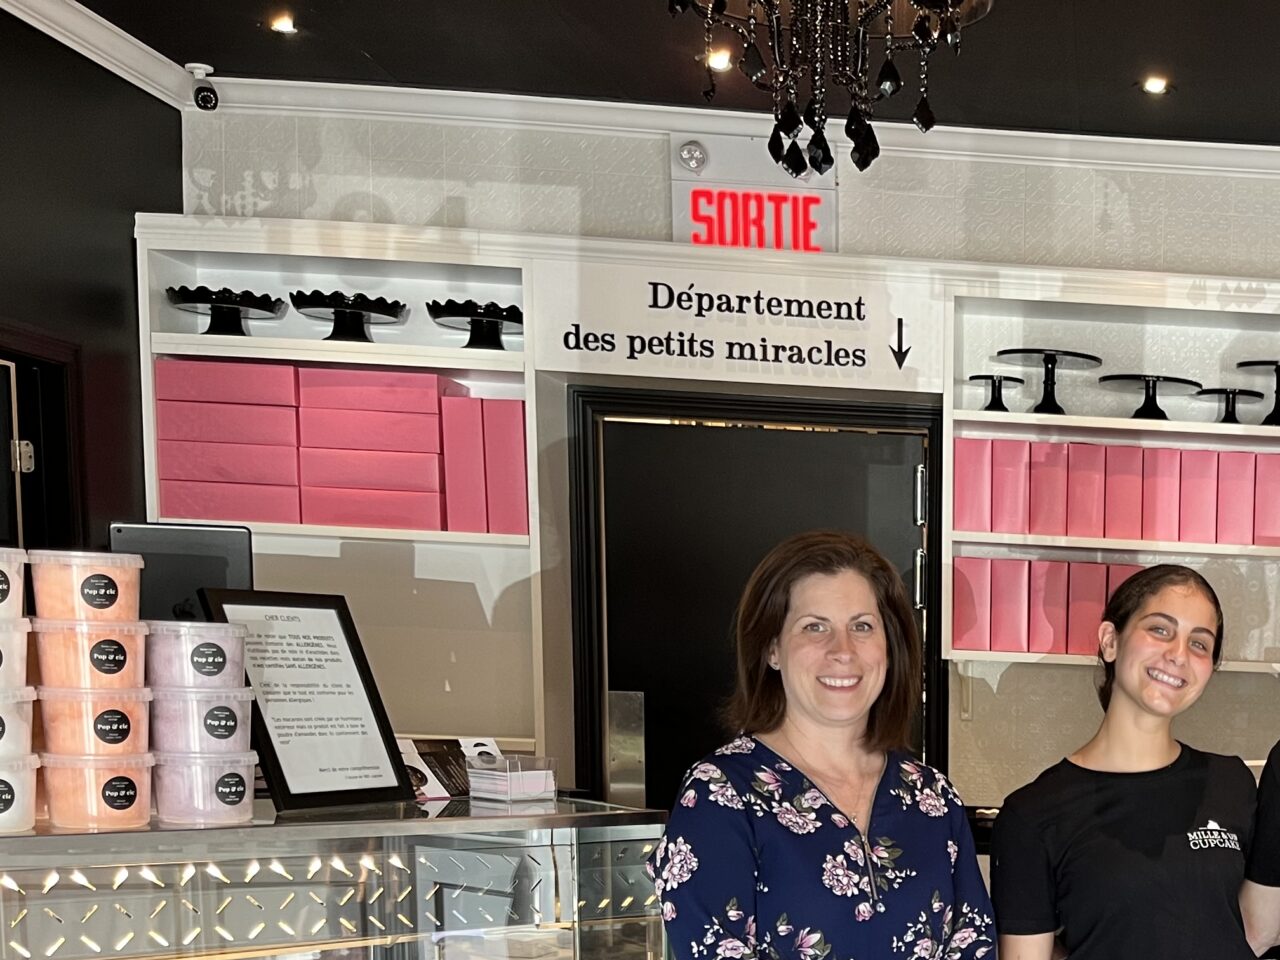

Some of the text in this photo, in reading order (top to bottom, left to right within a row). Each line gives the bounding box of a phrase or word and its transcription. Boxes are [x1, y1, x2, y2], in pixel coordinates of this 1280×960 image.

[690, 189, 823, 253] SORTIE
[648, 281, 866, 321] Département
[563, 323, 867, 367] des petits miracles
[1187, 831, 1220, 841] MILLE
[1190, 839, 1241, 851] CUPCAKE
